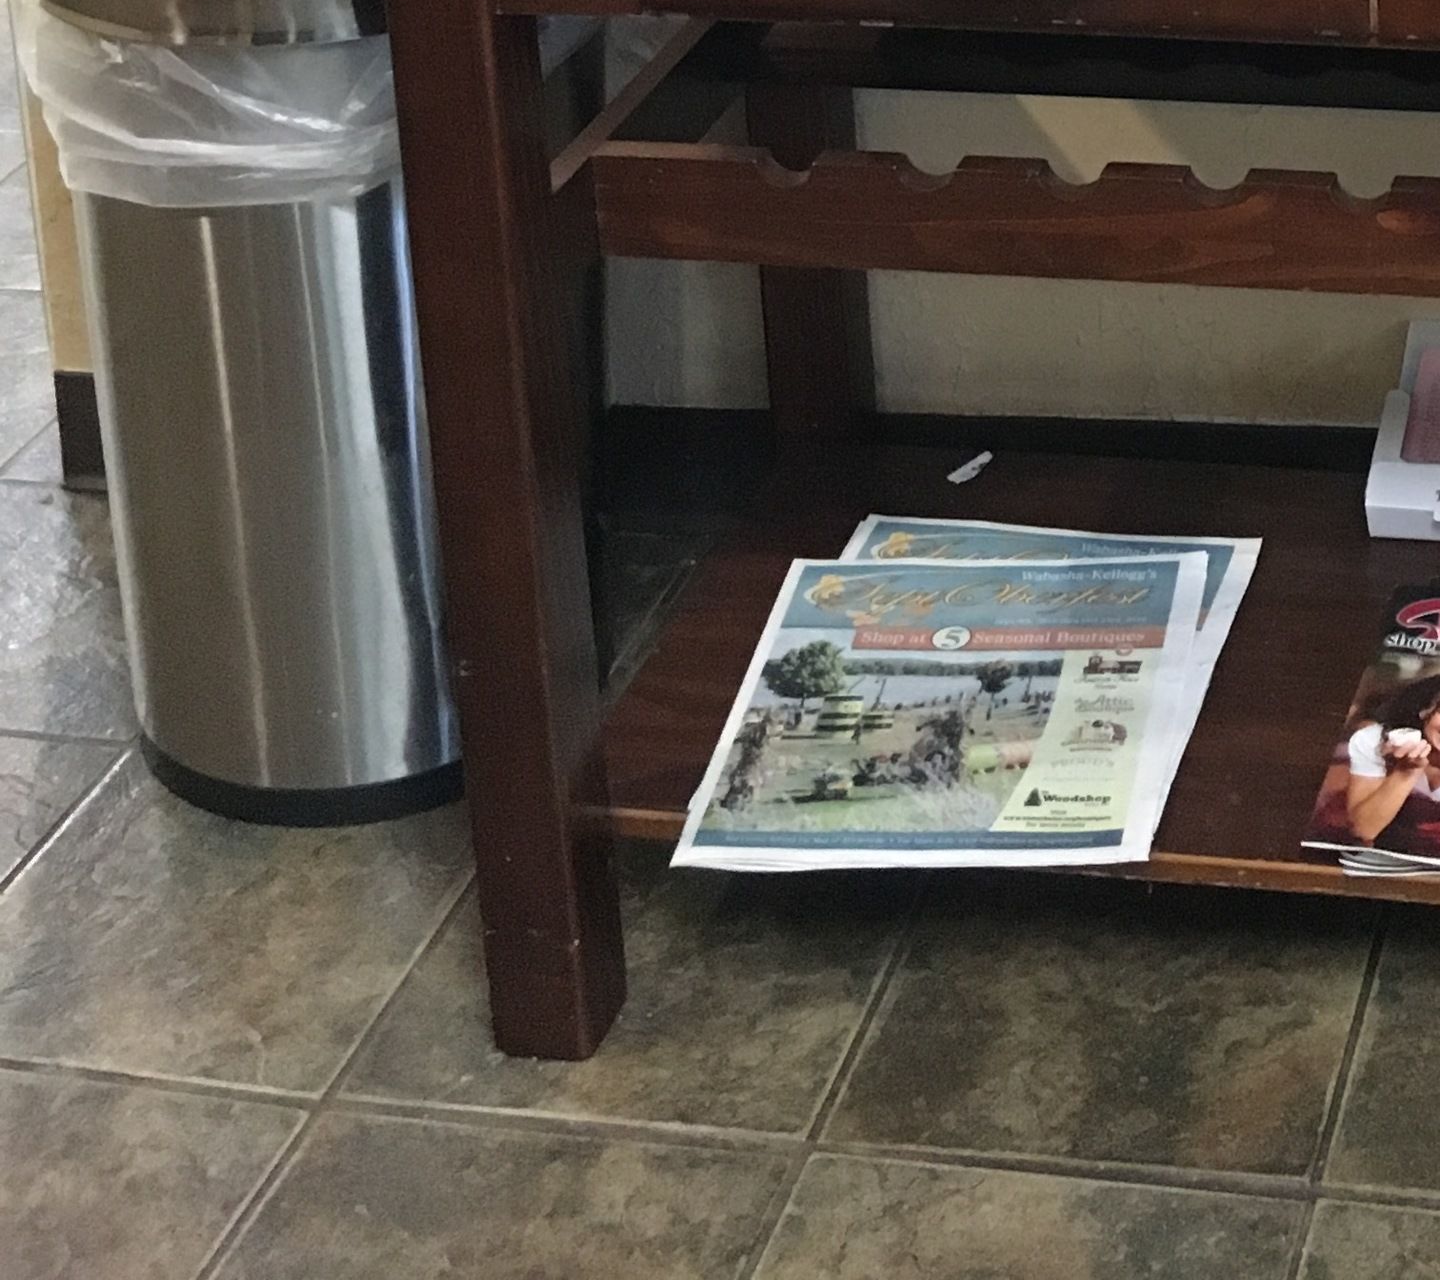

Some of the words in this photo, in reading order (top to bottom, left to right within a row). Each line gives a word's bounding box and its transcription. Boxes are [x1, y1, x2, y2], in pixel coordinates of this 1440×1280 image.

[860, 630, 905, 645] Shop
[907, 631, 926, 643] at
[943, 626, 965, 647] 5
[972, 630, 1052, 644] Seasonal
[1056, 629, 1146, 644] Boutiques
